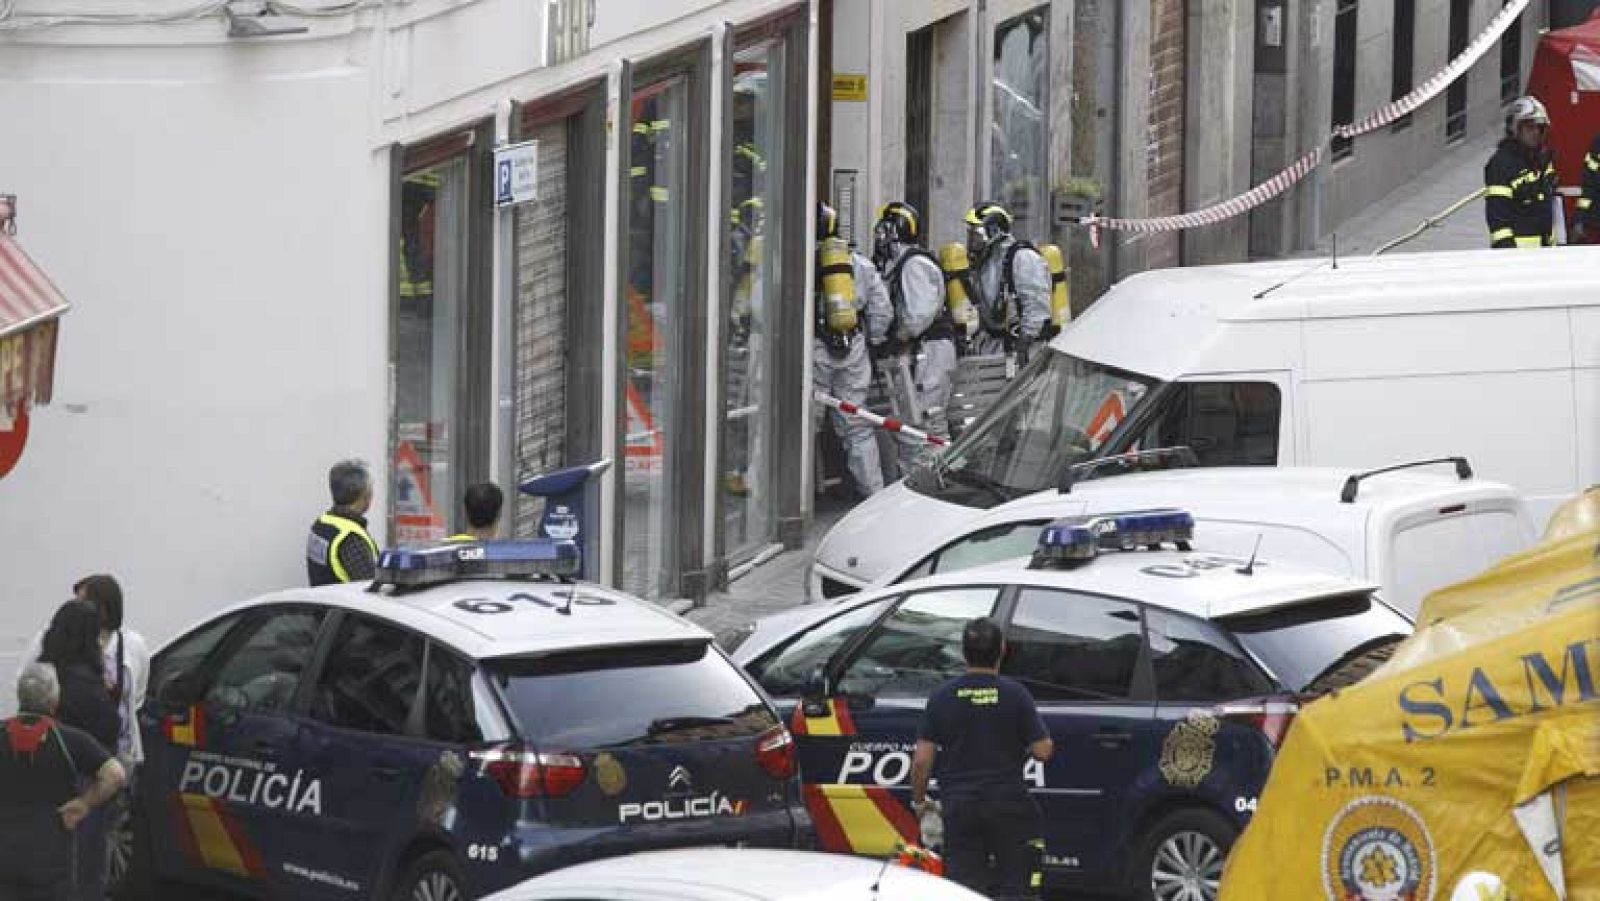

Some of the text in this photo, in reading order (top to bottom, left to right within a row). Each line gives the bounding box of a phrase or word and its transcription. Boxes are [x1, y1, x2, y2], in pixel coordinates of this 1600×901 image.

[180, 761, 321, 816] POLICÍA
[1421, 767, 1435, 786] 2
[619, 789, 734, 823] POLICÍA
[467, 843, 499, 862] 615
